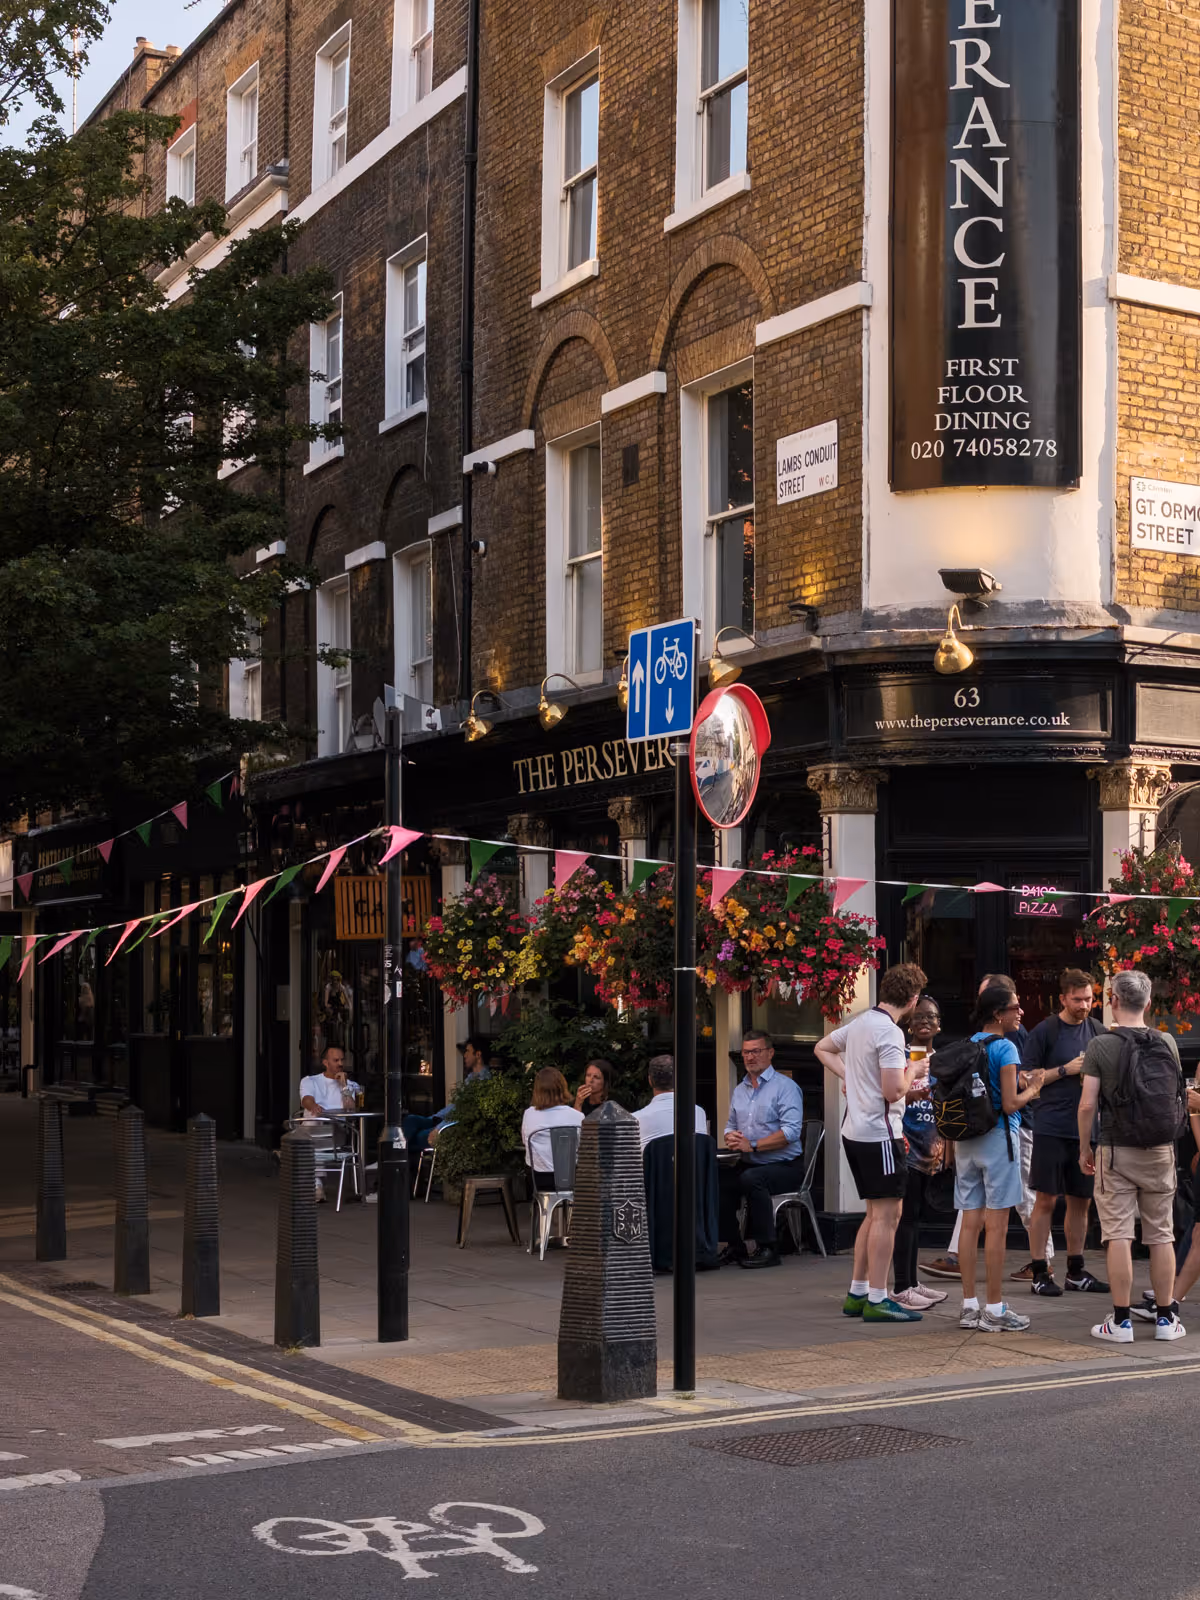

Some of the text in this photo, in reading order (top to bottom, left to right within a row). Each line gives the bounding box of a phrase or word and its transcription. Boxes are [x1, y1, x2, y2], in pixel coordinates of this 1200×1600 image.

[945, 358, 1019, 378] FIRST
[937, 385, 1029, 405] FLOOR
[934, 411, 1031, 431] DINING
[777, 442, 837, 477] LAMBS CONDUIT
[911, 438, 1058, 460] 020 74058278
[779, 475, 806, 498] STREET
[1135, 498, 1157, 517] GT.
[1136, 522, 1194, 545] STREET
[953, 687, 981, 709] 63
[875, 712, 1071, 731] www.theperseverance.co.uk
[512, 736, 677, 794] THE PERSEVER
